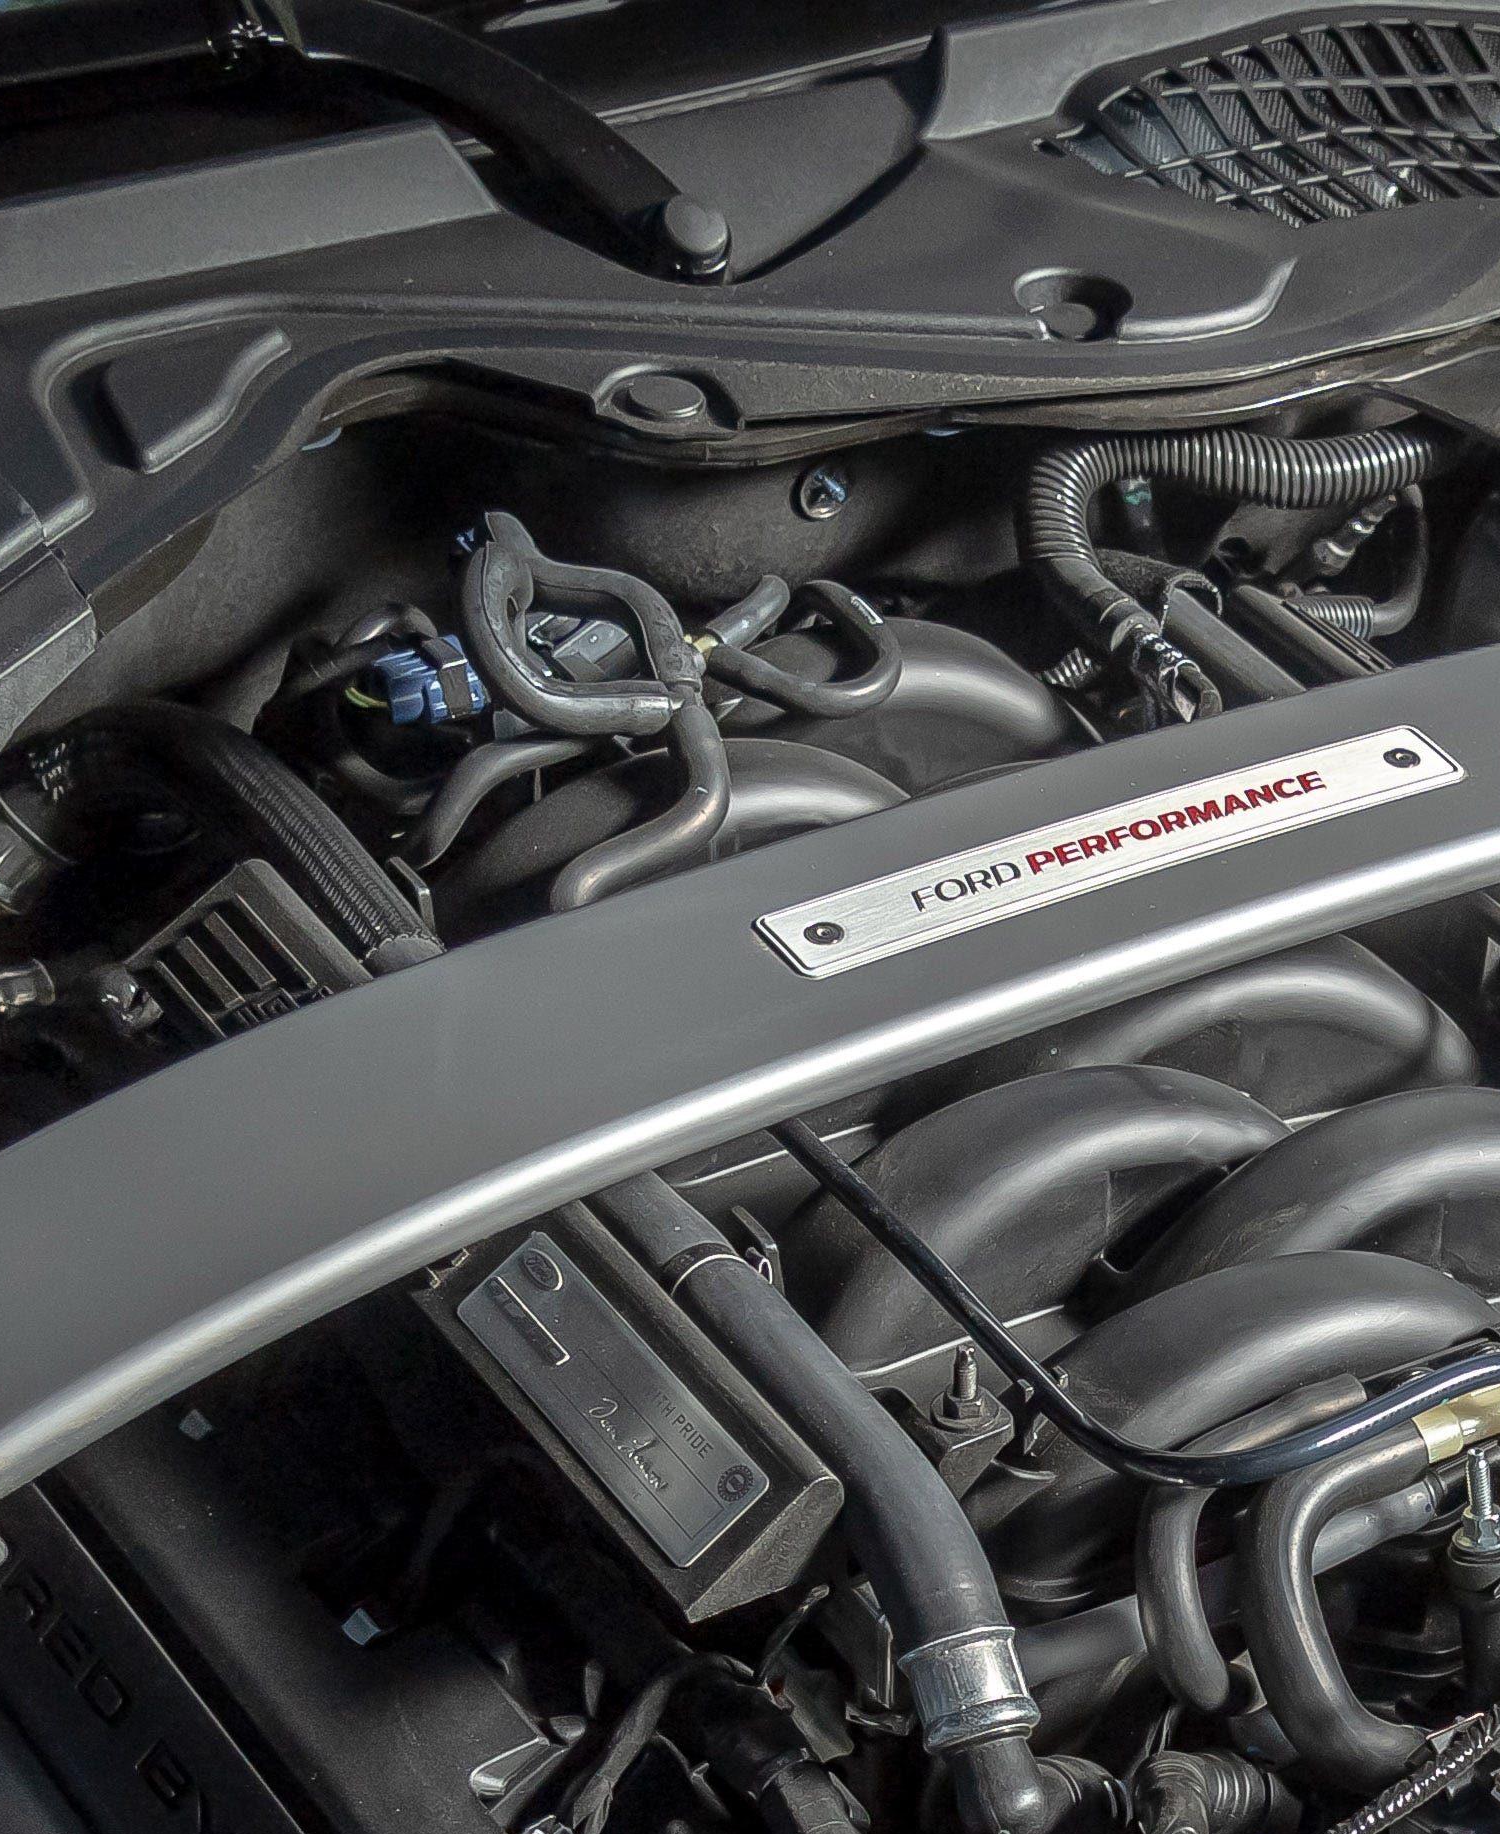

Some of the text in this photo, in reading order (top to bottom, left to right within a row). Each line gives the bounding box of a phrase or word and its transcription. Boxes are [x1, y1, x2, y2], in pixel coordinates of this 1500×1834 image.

[910, 770, 1328, 914] FORD PERFORMANCE
[670, 1414, 714, 1459] PRIDE
